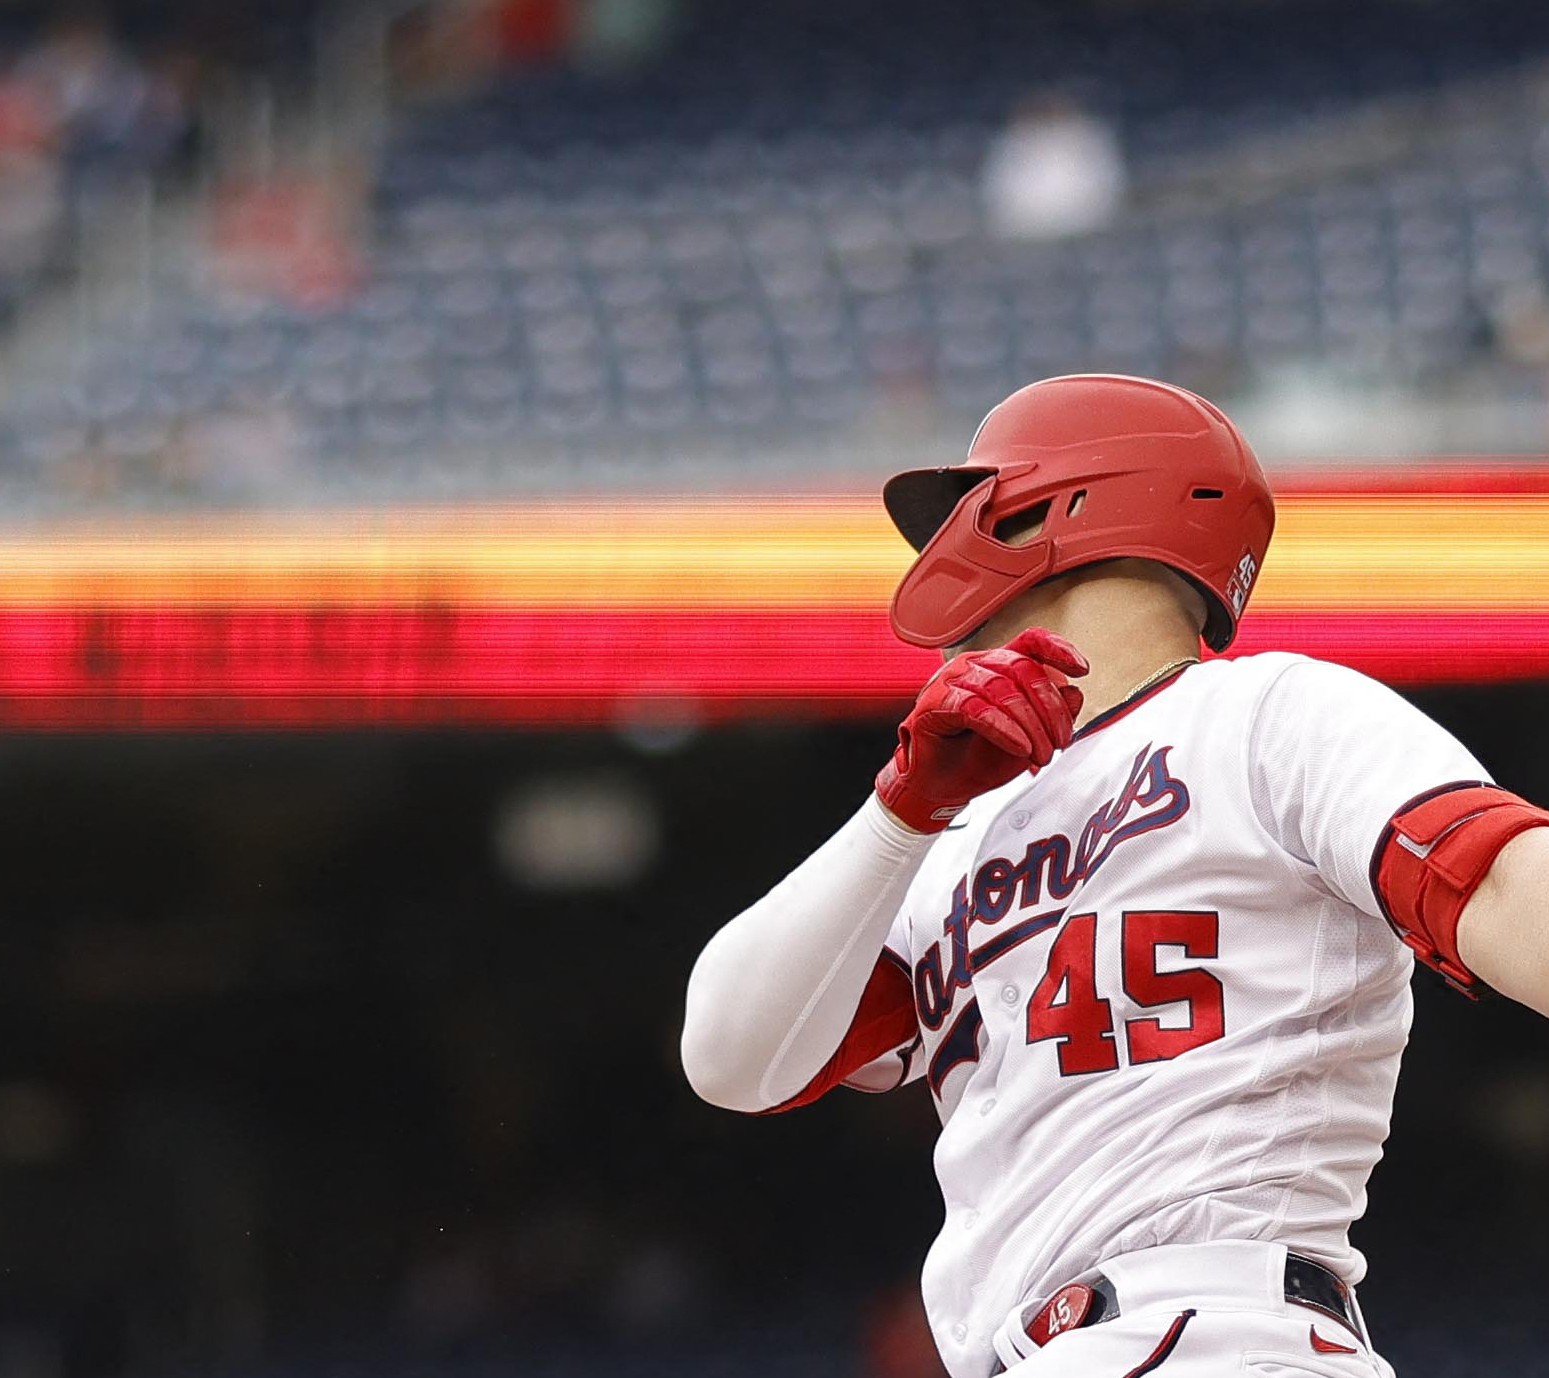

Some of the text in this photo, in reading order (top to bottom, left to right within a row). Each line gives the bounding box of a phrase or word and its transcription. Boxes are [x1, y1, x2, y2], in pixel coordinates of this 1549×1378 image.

[1239, 553, 1256, 590] 45
[1026, 910, 1225, 1077] 45
[1048, 1297, 1071, 1335] 45
